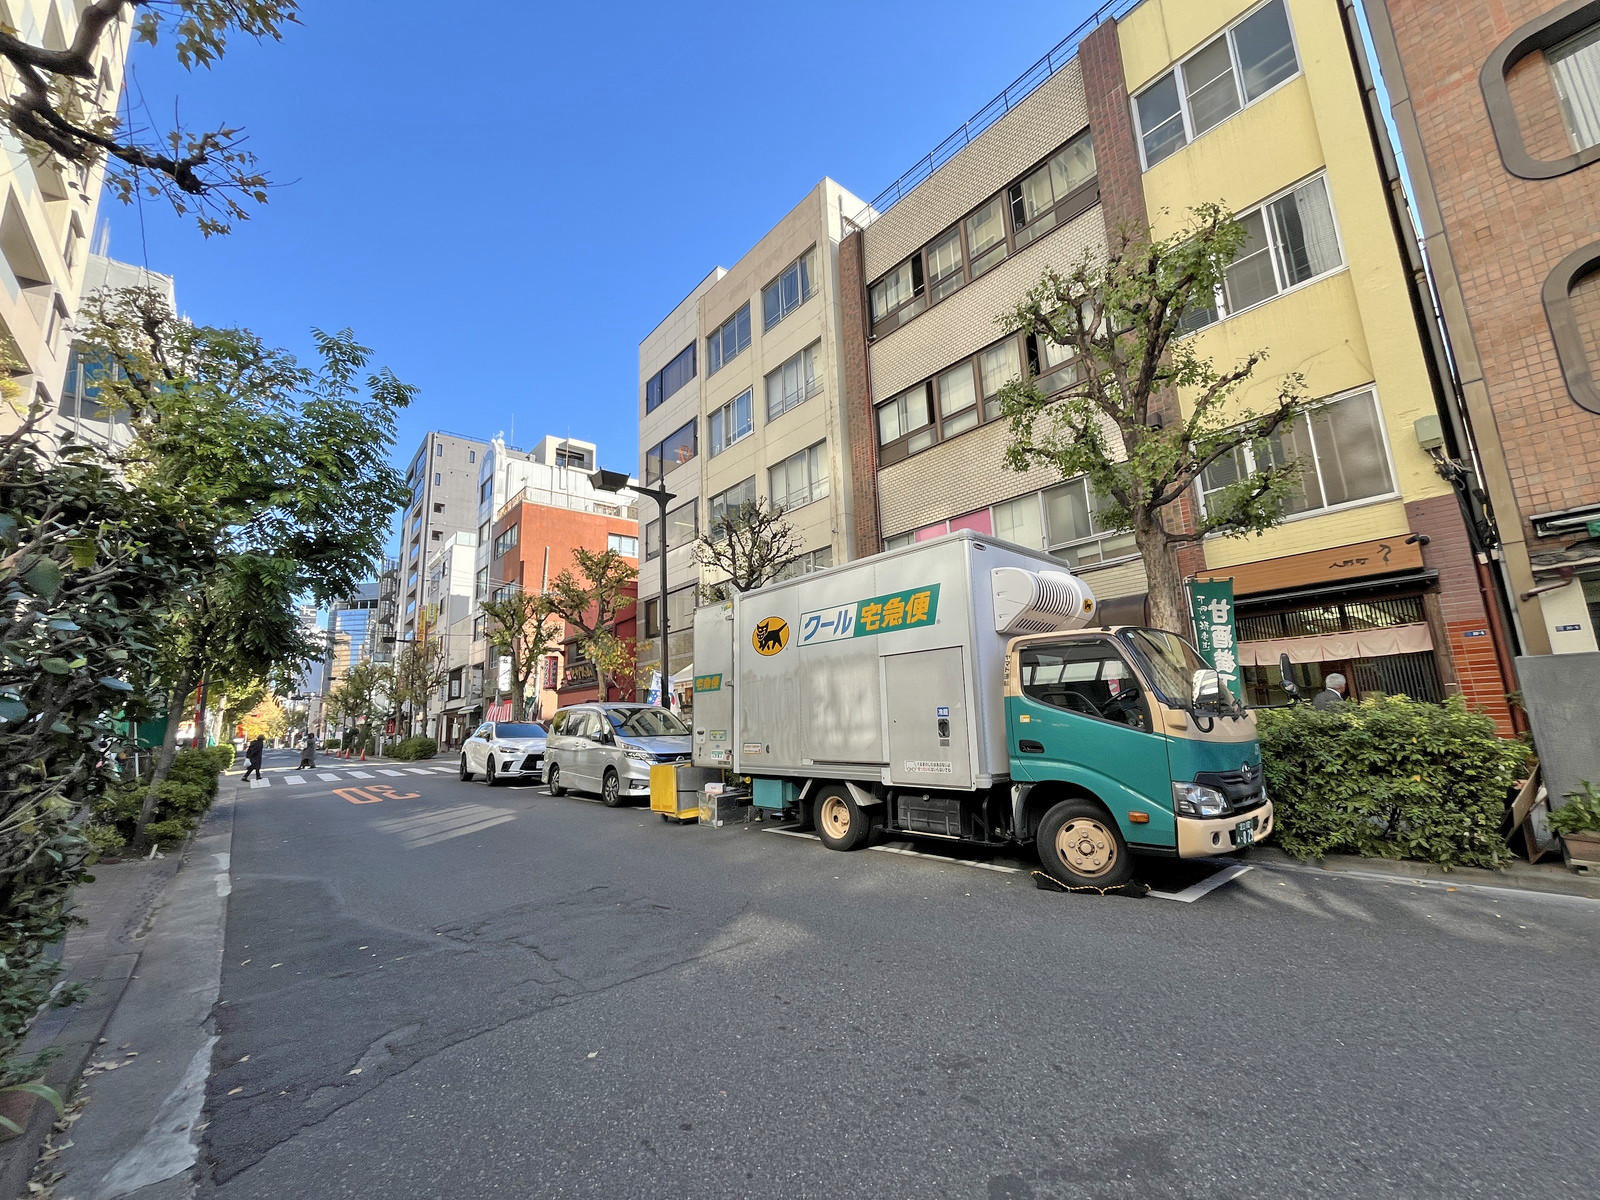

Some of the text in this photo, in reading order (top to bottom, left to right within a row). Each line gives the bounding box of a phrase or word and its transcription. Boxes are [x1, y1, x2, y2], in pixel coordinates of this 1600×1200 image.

[804, 591, 931, 641] クール 宅急便
[696, 676, 720, 690] 宅急便
[332, 784, 421, 805] 30
